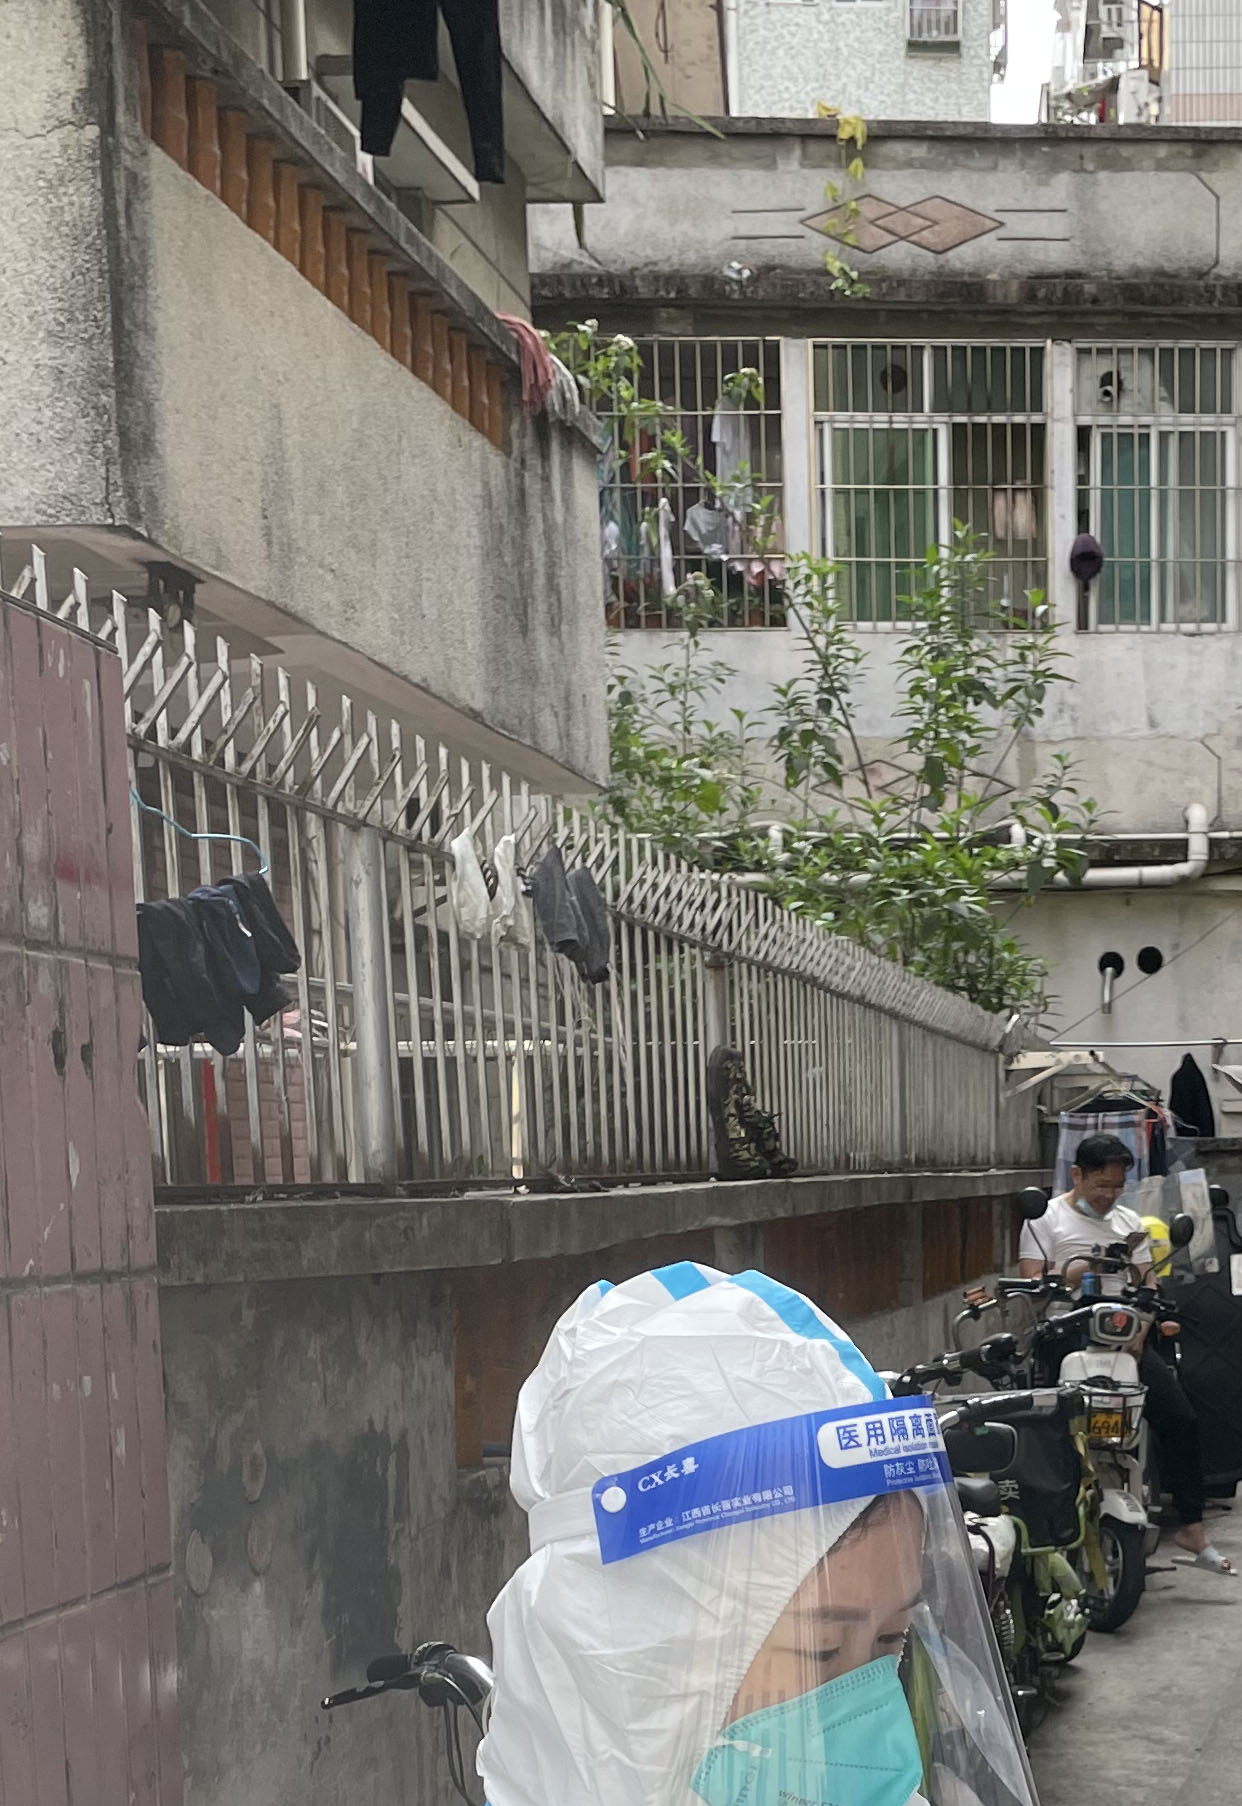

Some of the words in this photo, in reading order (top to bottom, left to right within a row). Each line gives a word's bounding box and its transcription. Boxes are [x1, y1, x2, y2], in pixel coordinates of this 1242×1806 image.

[836, 1413, 940, 1451] 医用隔离面
